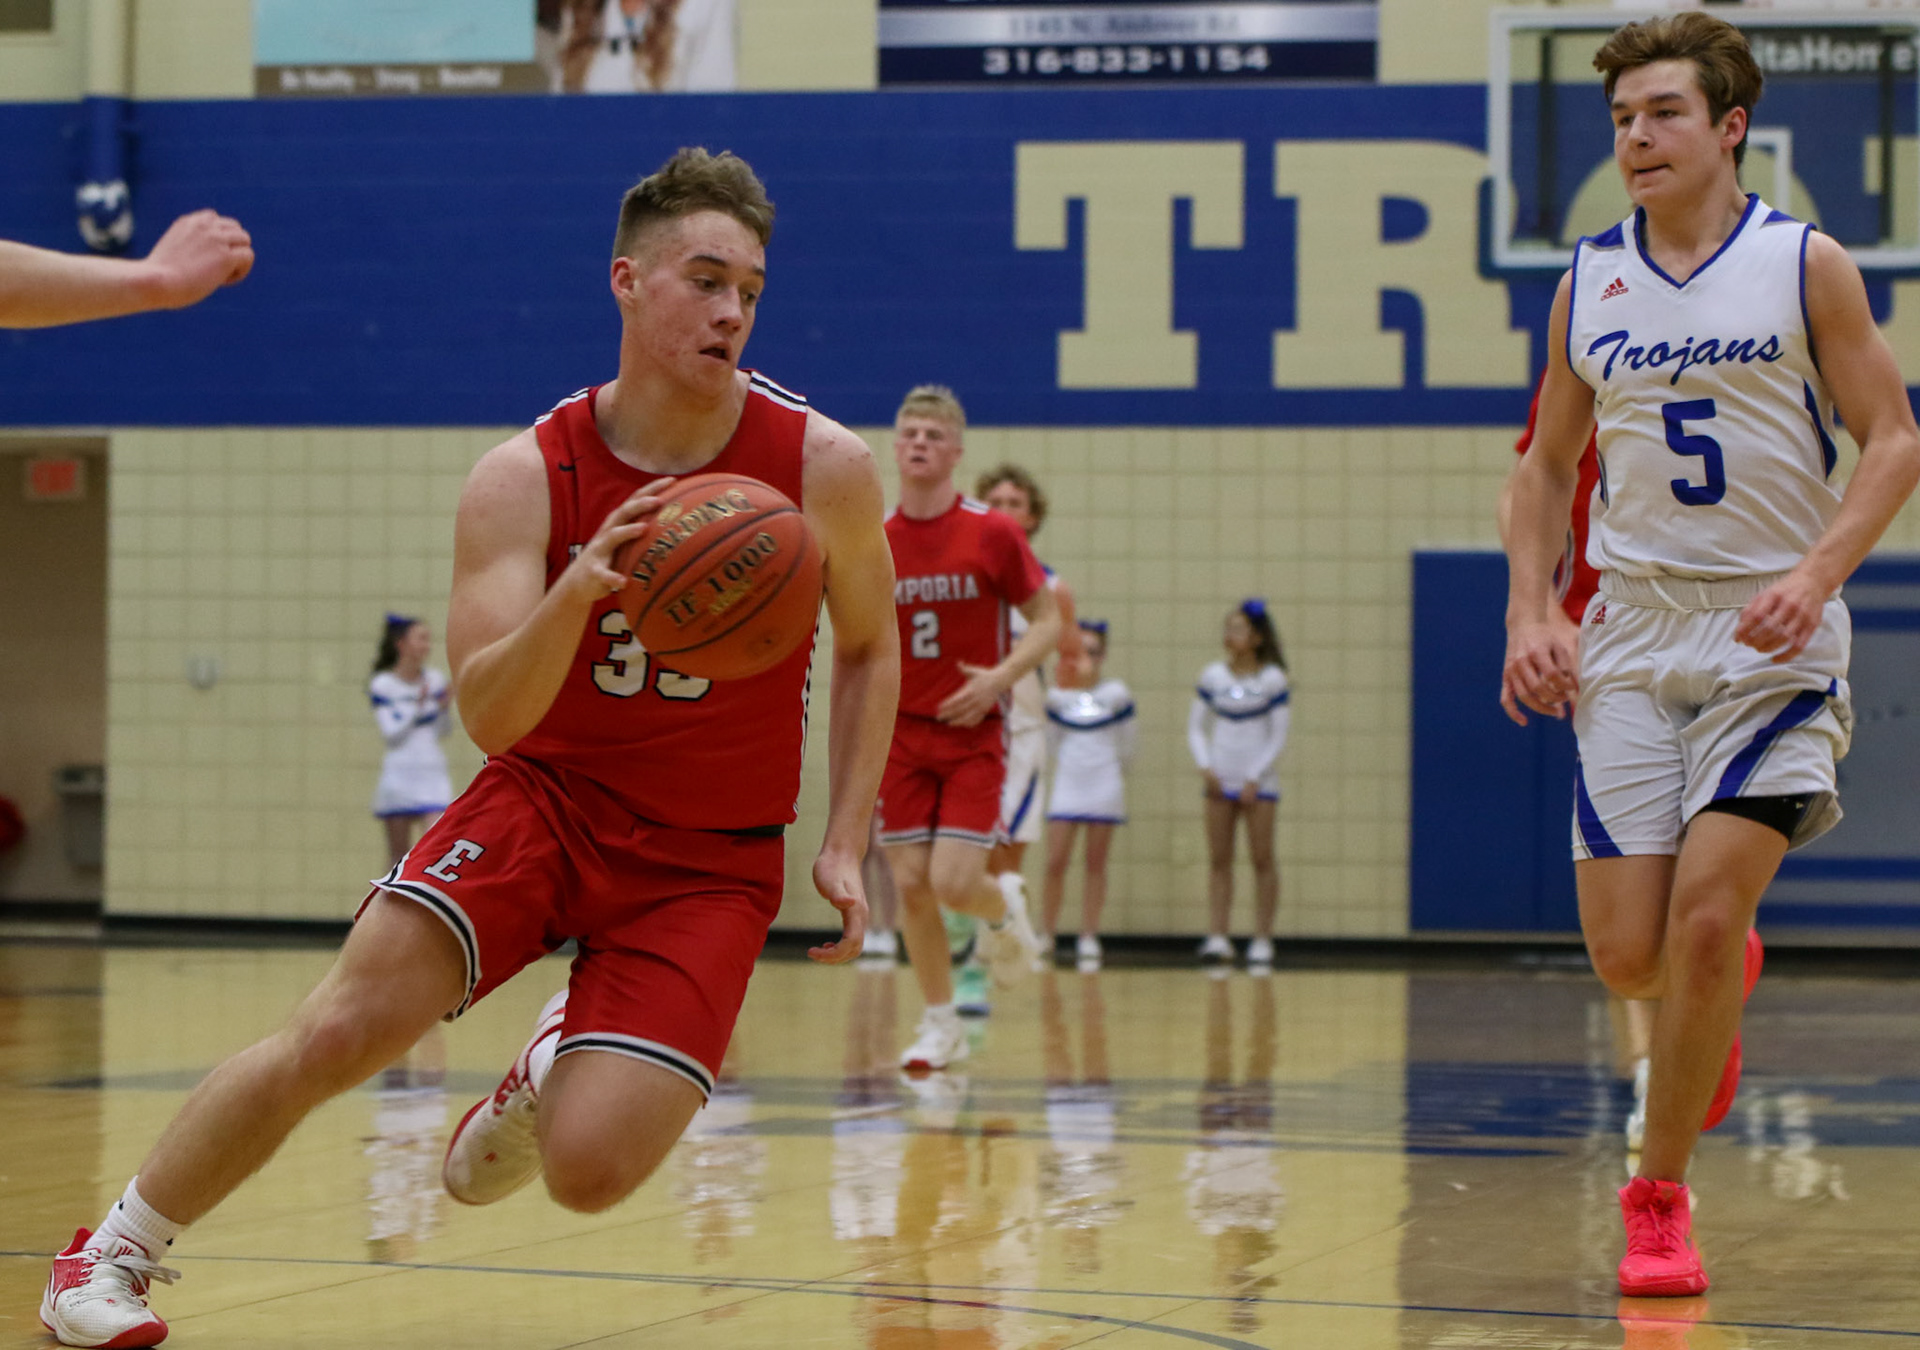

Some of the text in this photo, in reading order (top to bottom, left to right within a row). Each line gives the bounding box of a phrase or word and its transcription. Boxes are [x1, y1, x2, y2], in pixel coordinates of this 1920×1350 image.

[1587, 330, 1784, 386] Trojans
[1662, 398, 1727, 506] 5
[707, 532, 776, 593] 1000
[911, 609, 940, 659] 2
[423, 838, 486, 883] E
